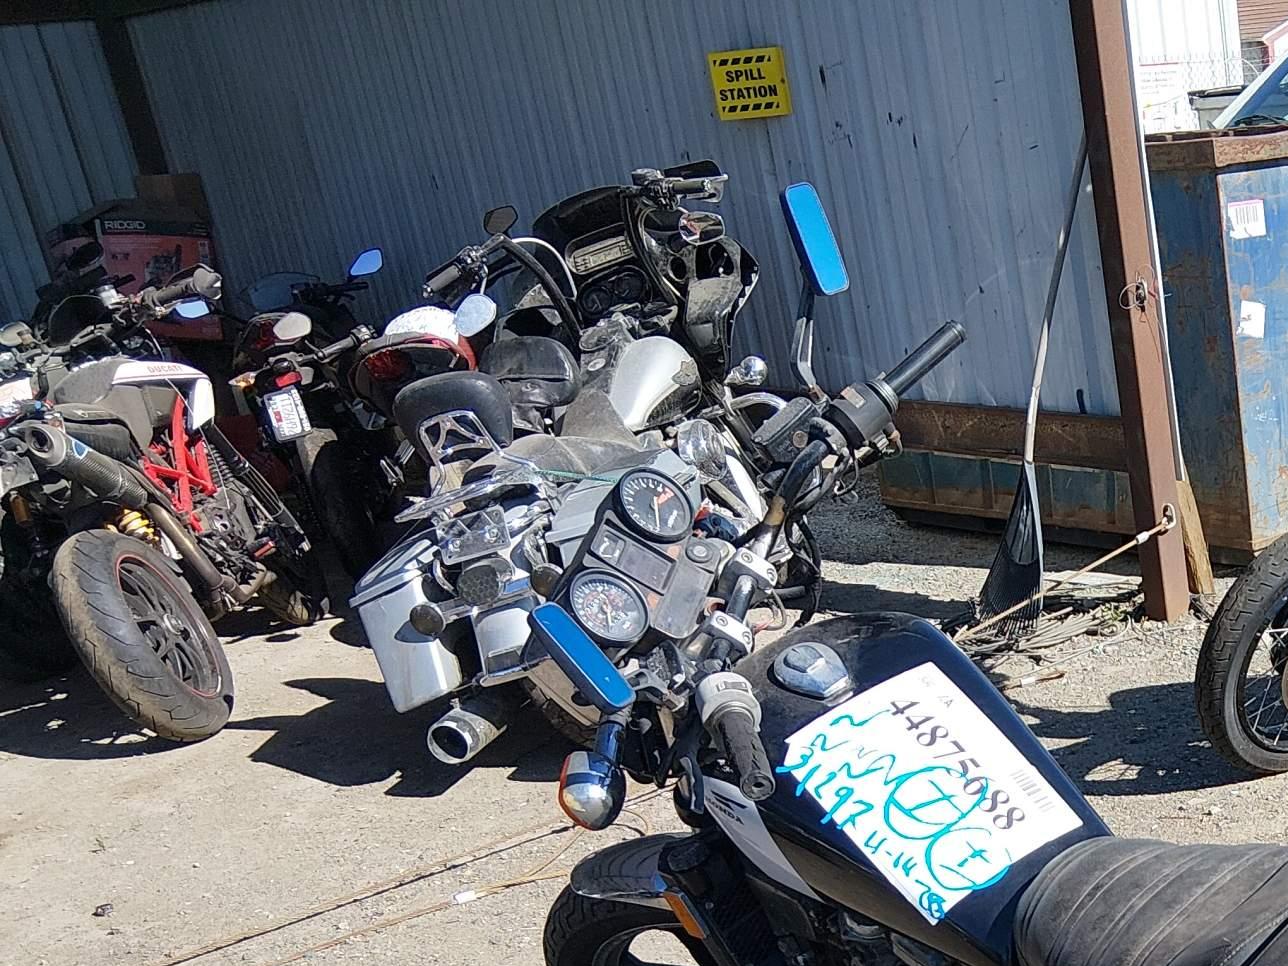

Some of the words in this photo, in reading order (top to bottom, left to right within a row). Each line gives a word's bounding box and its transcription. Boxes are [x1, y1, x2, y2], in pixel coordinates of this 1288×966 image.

[725, 68, 766, 83] SPILL
[719, 84, 778, 101] STATION
[104, 220, 146, 230] RIDGID
[147, 365, 183, 374] DUCATI
[889, 700, 1026, 830] 44875688
[704, 795, 745, 826] HONDA
